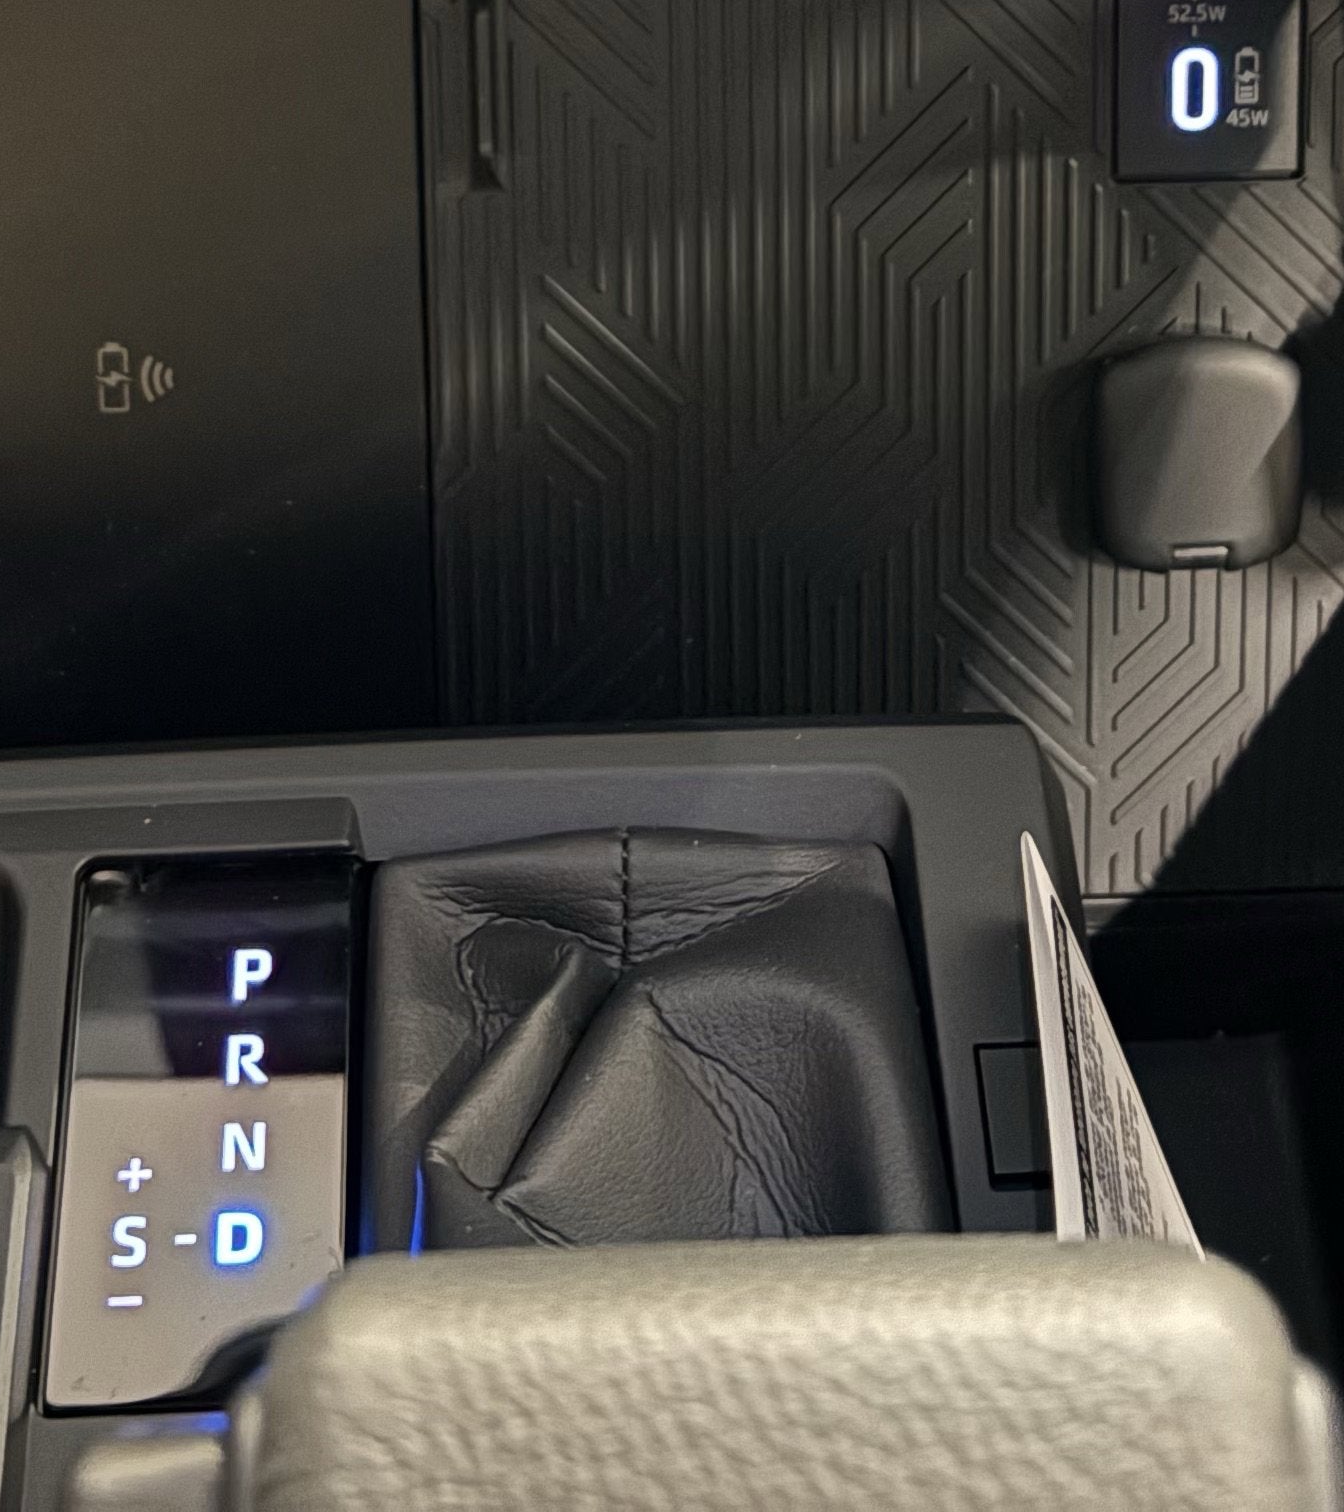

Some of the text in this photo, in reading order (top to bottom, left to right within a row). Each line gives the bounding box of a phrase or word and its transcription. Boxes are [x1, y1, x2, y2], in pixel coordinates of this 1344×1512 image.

[1167, 3, 1227, 24] 52.5W
[1171, 46, 1219, 132] 0
[1225, 108, 1269, 128] 45W
[231, 948, 274, 1002] P
[226, 1034, 269, 1086] R
[221, 1121, 268, 1173] N
[110, 1215, 148, 1269] S
[214, 1211, 265, 1267] D
